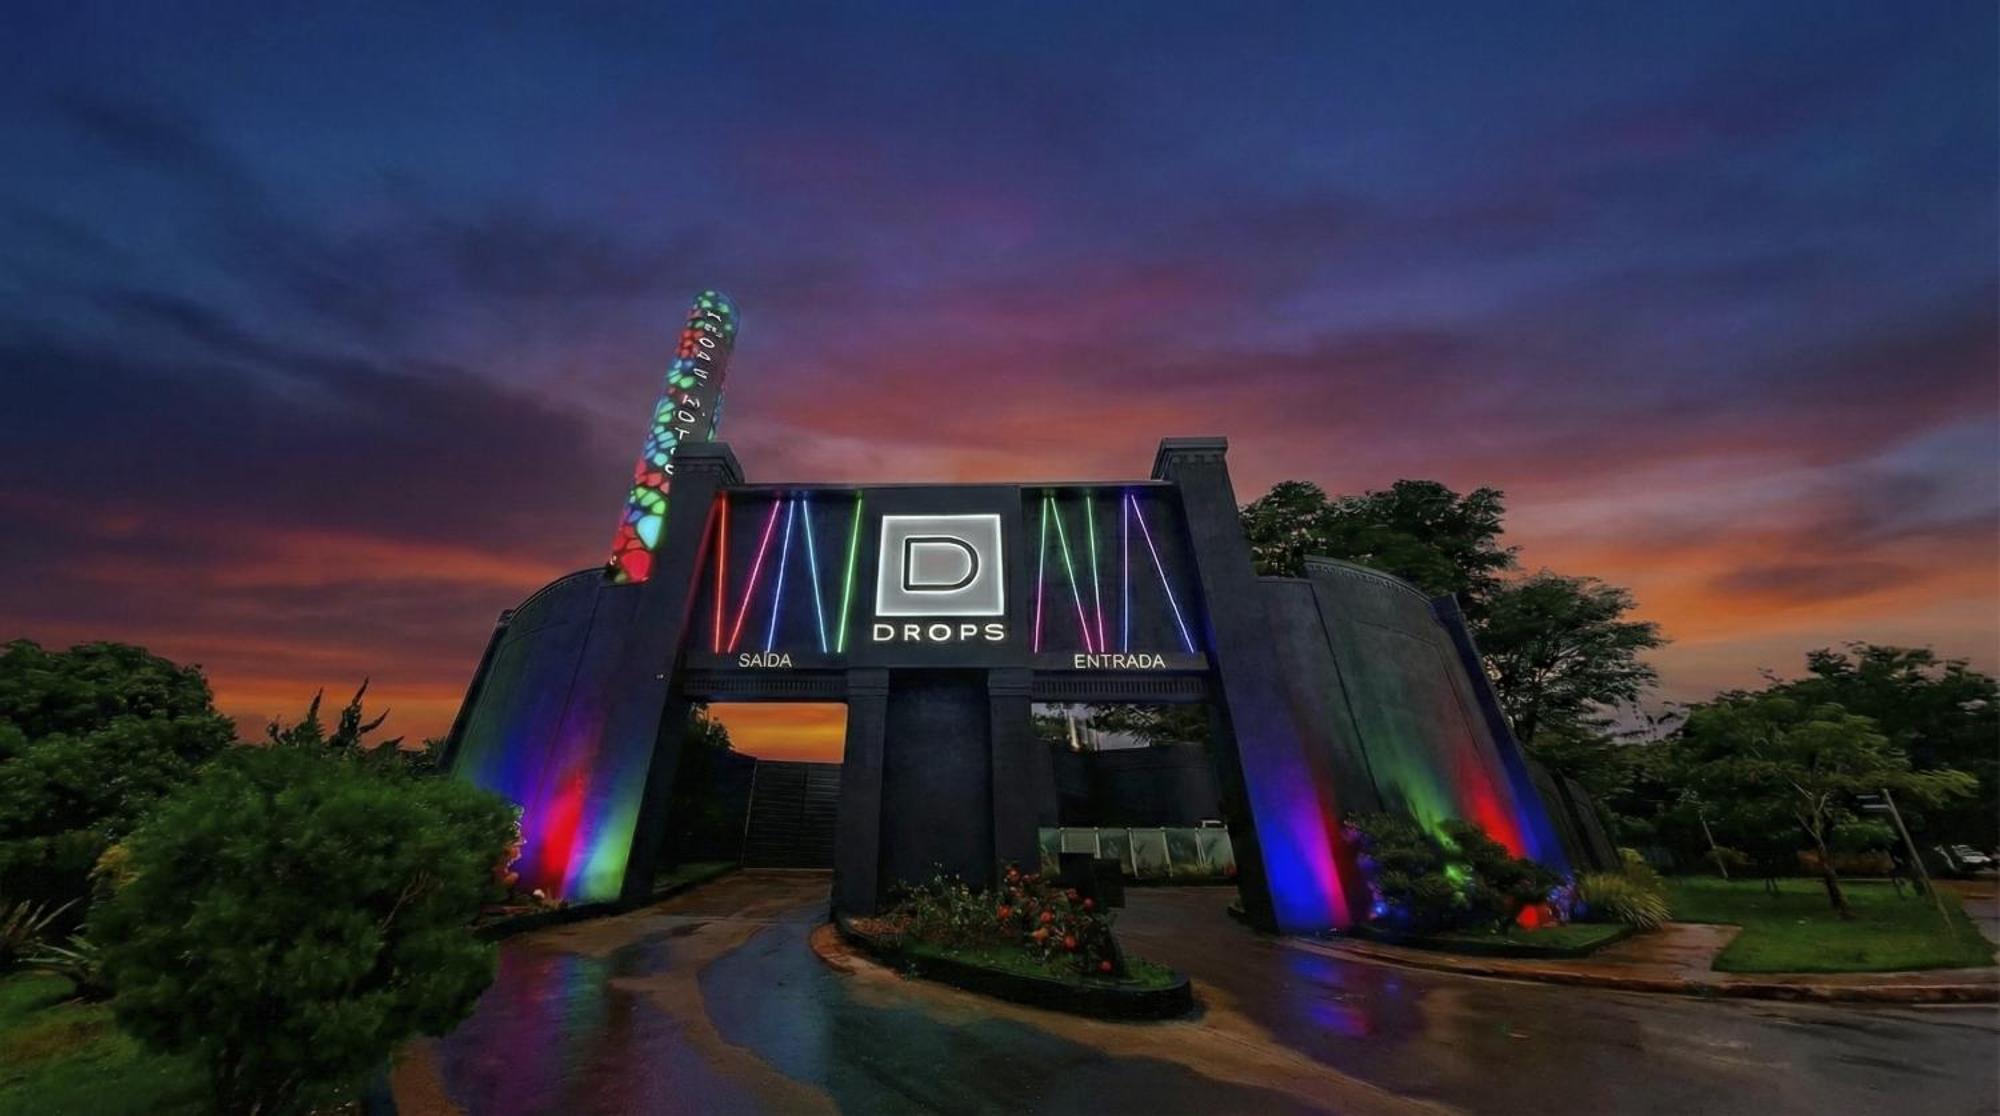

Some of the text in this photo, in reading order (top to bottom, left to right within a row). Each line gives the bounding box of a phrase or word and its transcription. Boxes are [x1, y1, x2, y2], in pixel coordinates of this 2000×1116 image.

[902, 535, 981, 593] D
[872, 623, 1006, 642] DROPS
[738, 651, 793, 668] SAÍDA
[1073, 653, 1167, 669] ENTRADA
